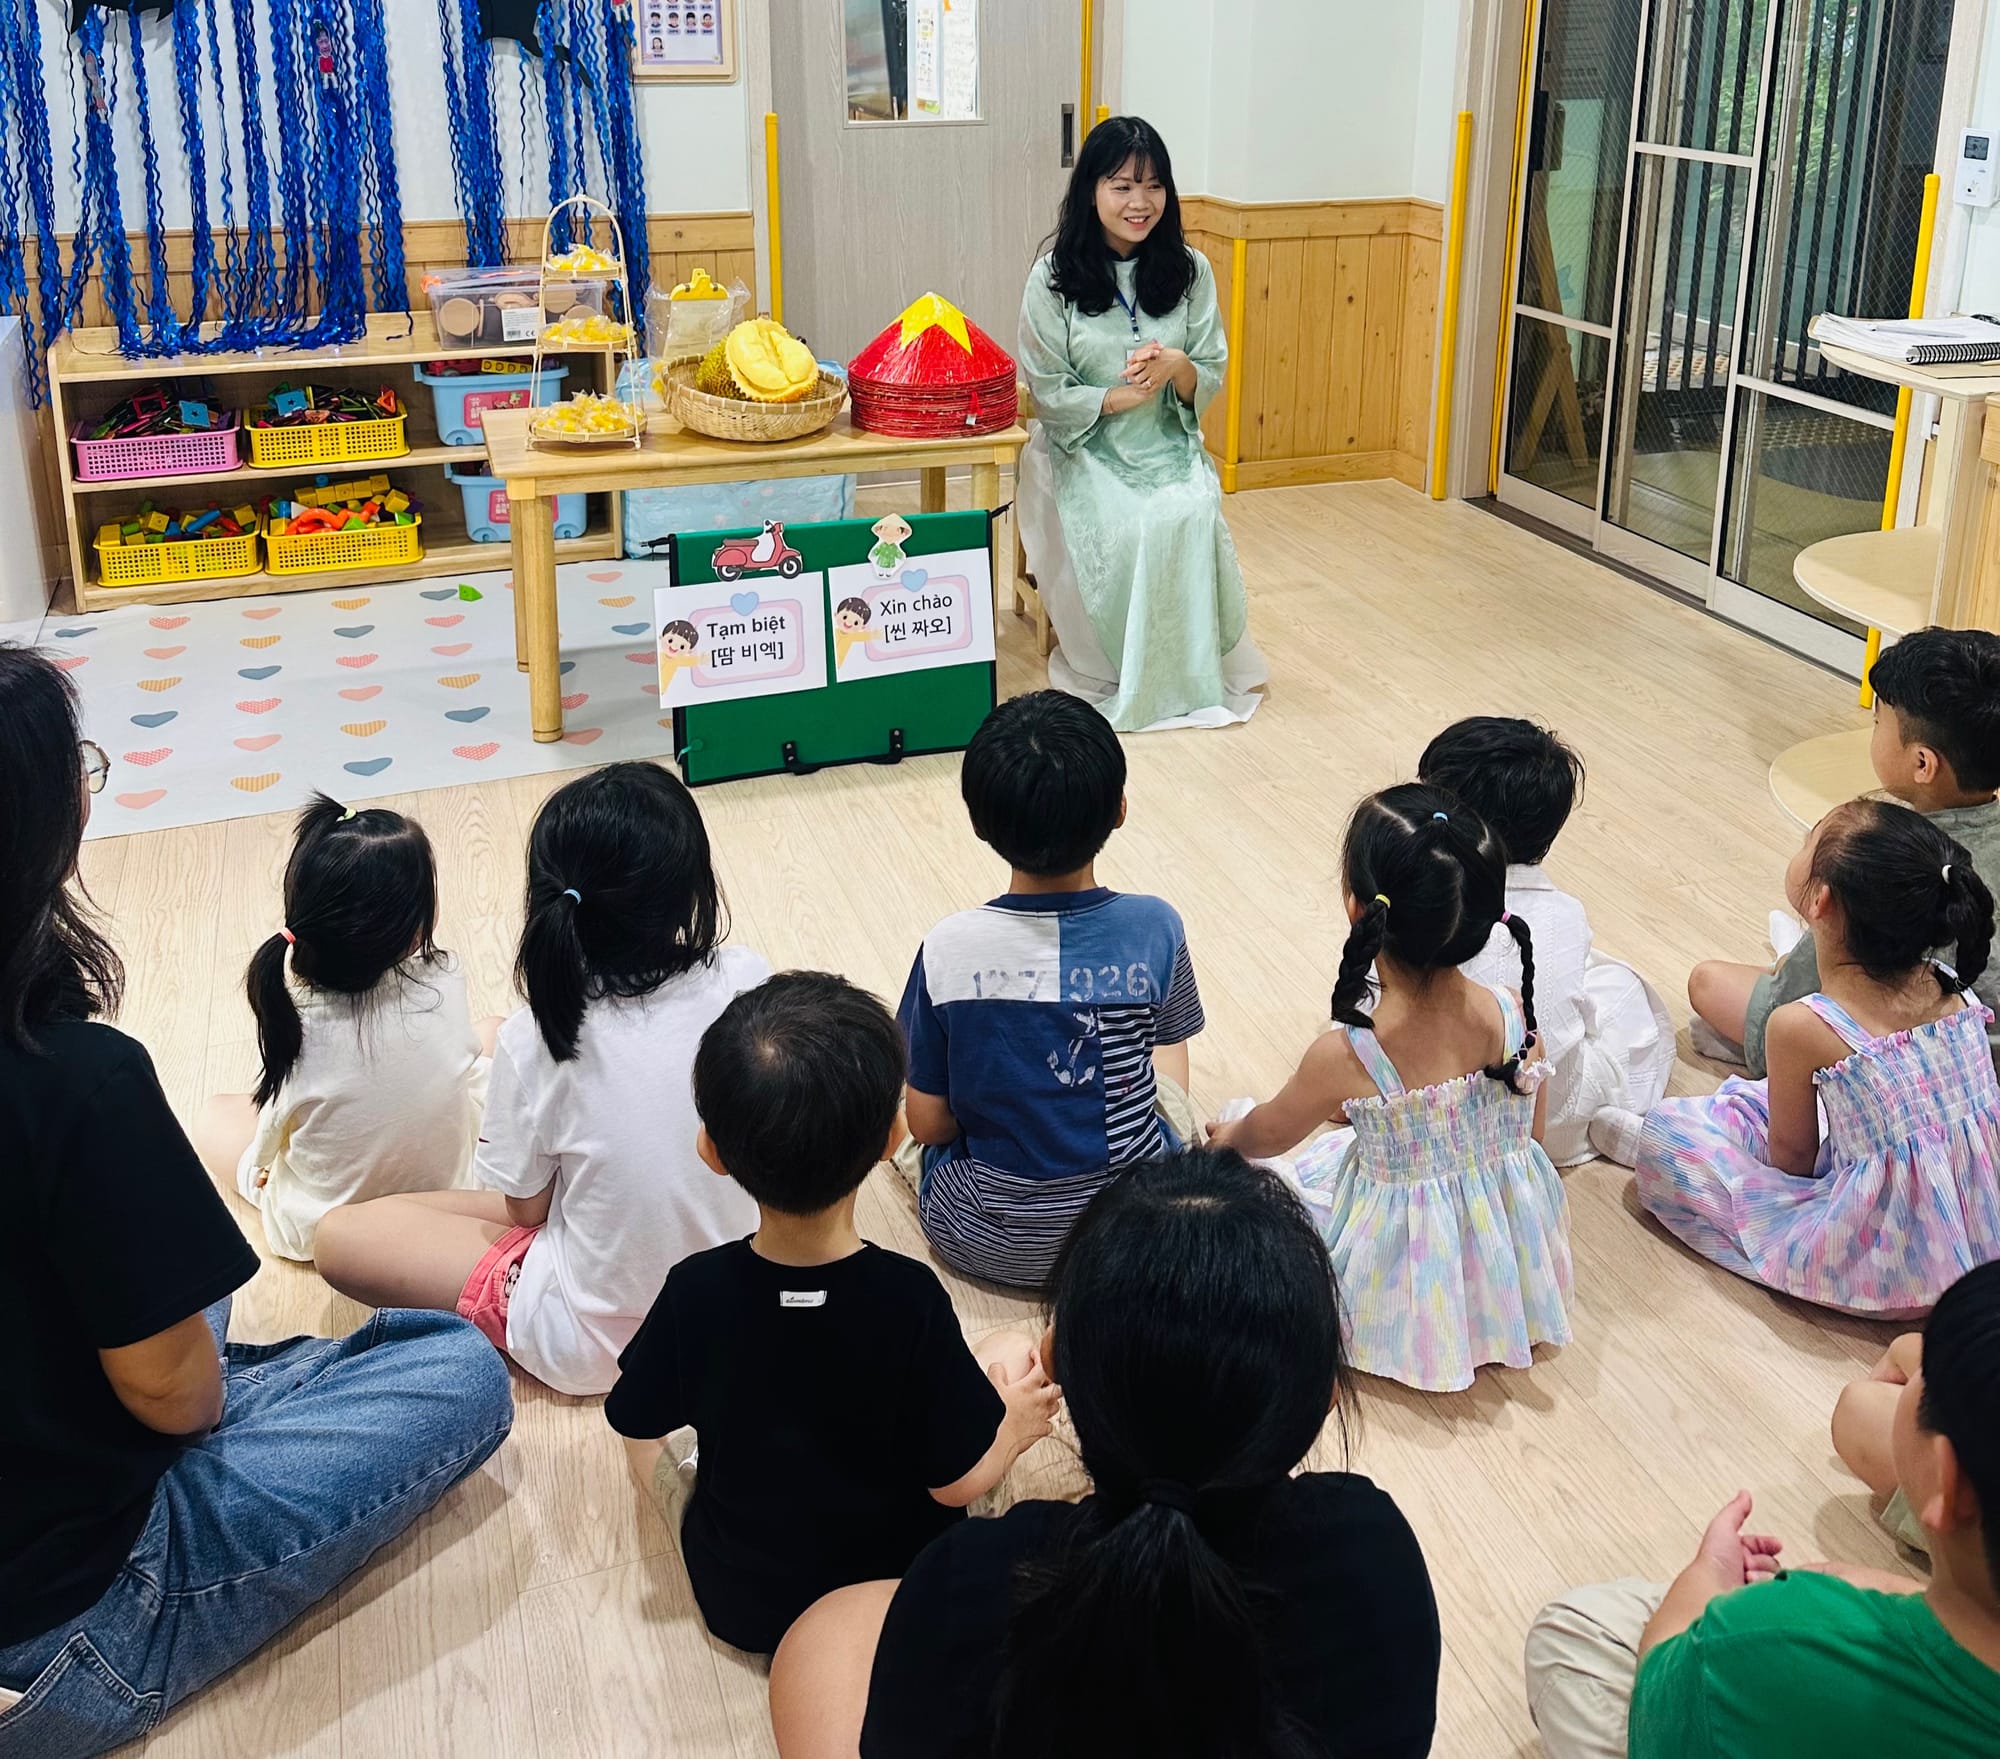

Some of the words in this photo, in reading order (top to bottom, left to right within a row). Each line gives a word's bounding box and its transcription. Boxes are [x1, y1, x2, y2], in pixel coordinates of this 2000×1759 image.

[880, 599, 907, 617] Xin
[912, 594, 953, 612] chào
[706, 622, 746, 640] Tạm
[752, 616, 786, 634] biệt
[884, 622, 907, 644] [씬
[911, 615, 952, 638] 짜오]
[711, 646, 736, 668] [땀
[741, 641, 784, 662] 비엑]
[1069, 962, 1149, 1002] 926
